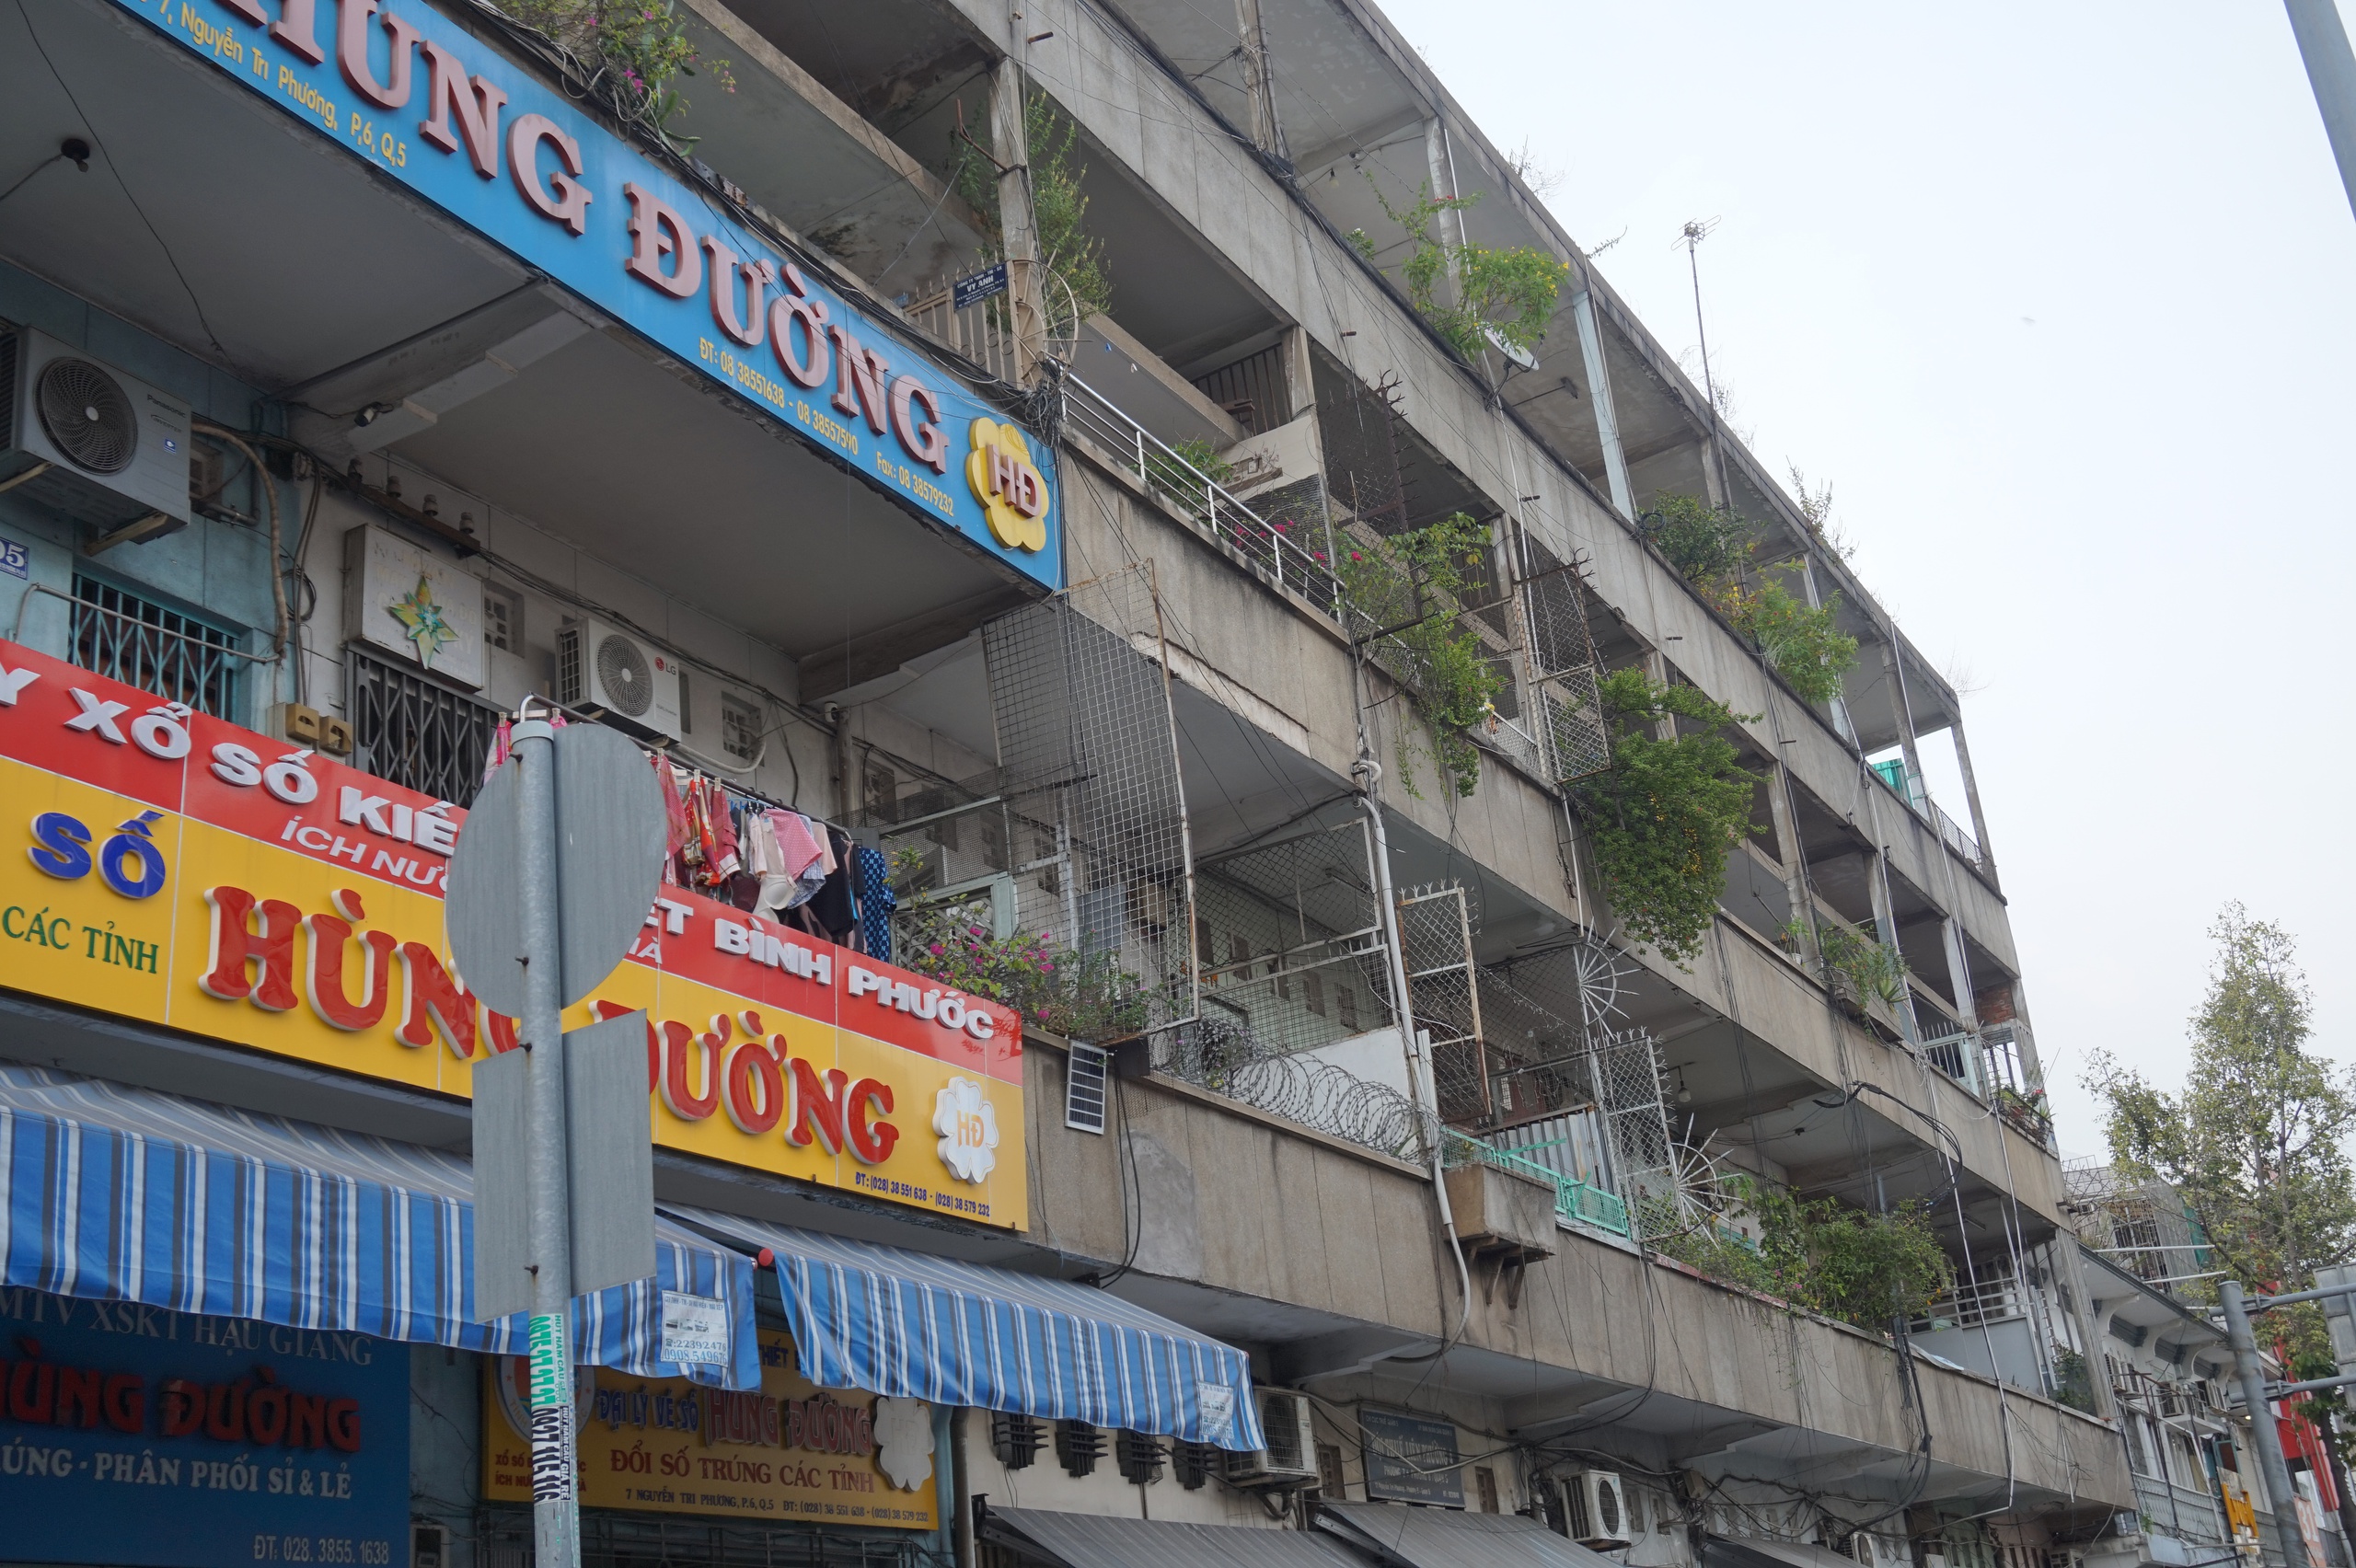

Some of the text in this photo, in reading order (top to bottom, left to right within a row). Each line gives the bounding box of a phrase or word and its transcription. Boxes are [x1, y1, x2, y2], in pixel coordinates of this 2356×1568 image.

[180, 7, 243, 63] Nguyễn
[966, 282, 976, 293] VY
[624, 181, 950, 476] ĐƯỜNG
[720, 351, 734, 376] 08
[737, 361, 785, 409] 38551638
[797, 399, 810, 424] 08
[813, 409, 859, 455] 38557590
[876, 451, 896, 479] Fax:
[898, 466, 910, 489] 08
[912, 475, 955, 516] 38579232
[986, 444, 1043, 518] HĐ
[665, 663, 676, 675] LG
[27, 809, 167, 900] SỐ
[64, 686, 191, 760] XỔ
[210, 742, 318, 805] SỐ
[340, 785, 457, 858] KIẾ
[715, 917, 832, 986] BÌNH
[849, 965, 995, 1040] PHƯỚC
[281, 815, 364, 864] ÍCH
[2, 905, 159, 975] CÁC TỈNH
[956, 1110, 985, 1148] HĐ
[871, 1175, 889, 1194] (028)
[891, 1181, 900, 1194] 38
[901, 1183, 912, 1198] 551
[914, 1186, 927, 1202] 638
[935, 1191, 953, 1211] (028)
[954, 1197, 964, 1211] 38
[964, 1200, 976, 1214] 579
[977, 1203, 990, 1217] 232
[88, 1301, 185, 1341] XSKT
[270, 1330, 372, 1366] GIANG
[0, 1337, 362, 1453] ÙNG ĐƯỜNG
[789, 1393, 872, 1456] ĐƯỜNG
[95, 1448, 180, 1487] PHÂN
[190, 1453, 259, 1493] PHỐI
[299, 1473, 314, 1497] &
[319, 1461, 352, 1500] LẺ
[495, 1470, 513, 1486] ÍCH
[512, 1452, 525, 1468] SỐ
[610, 1439, 874, 1493] ĐỔI SỐ TRÚNG CÁC TỈNH
[626, 1488, 632, 1500] 7
[636, 1485, 675, 1504] NGUYỄN
[680, 1493, 697, 1505] TRI
[800, 1501, 823, 1515] (028)
[825, 1503, 834, 1515] 38
[837, 1505, 849, 1516] 551
[851, 1505, 864, 1517] 638
[872, 1506, 891, 1521] (028)
[892, 1508, 901, 1520] 38
[903, 1510, 914, 1521] 579
[916, 1511, 929, 1523] 232
[254, 1534, 389, 1565] ĐT: 028. 3855. 1638
